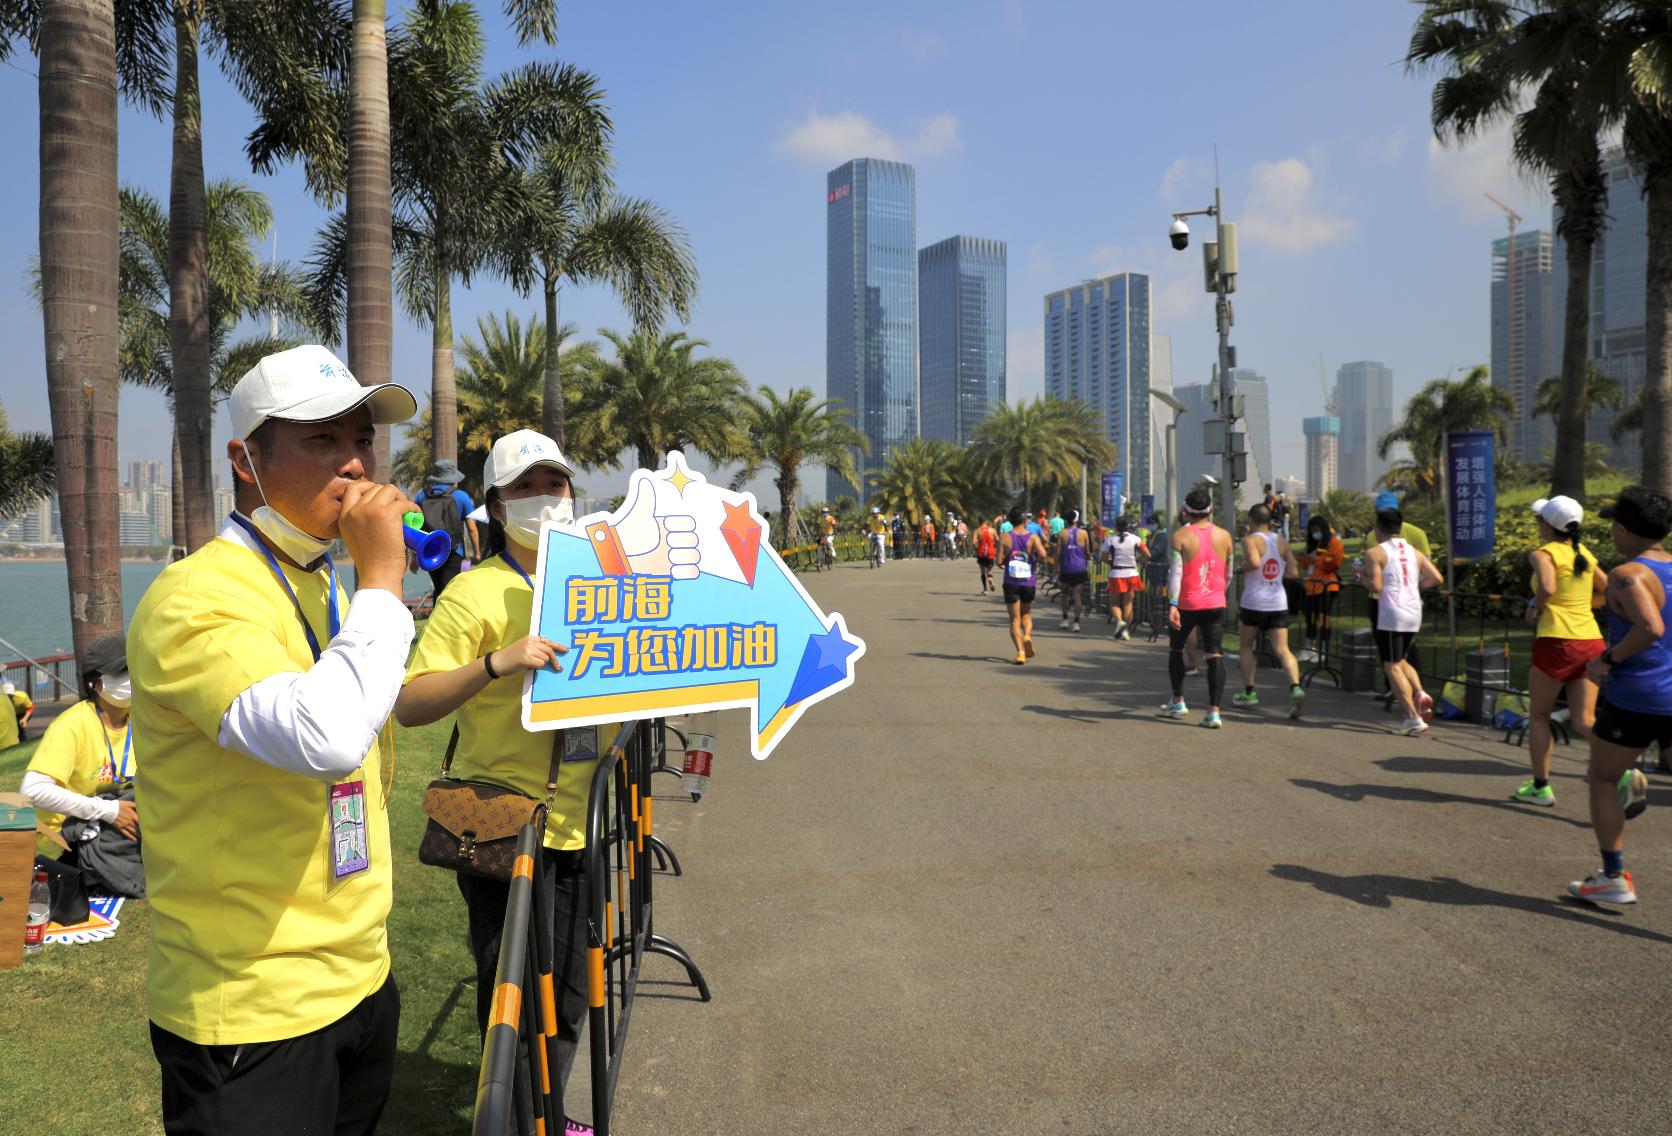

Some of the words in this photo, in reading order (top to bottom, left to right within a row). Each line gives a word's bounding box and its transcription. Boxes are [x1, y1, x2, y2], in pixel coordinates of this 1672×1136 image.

[1456, 457, 1470, 540] 发展体育运动
[566, 576, 671, 623] 前海
[572, 624, 776, 678] 为您加油
